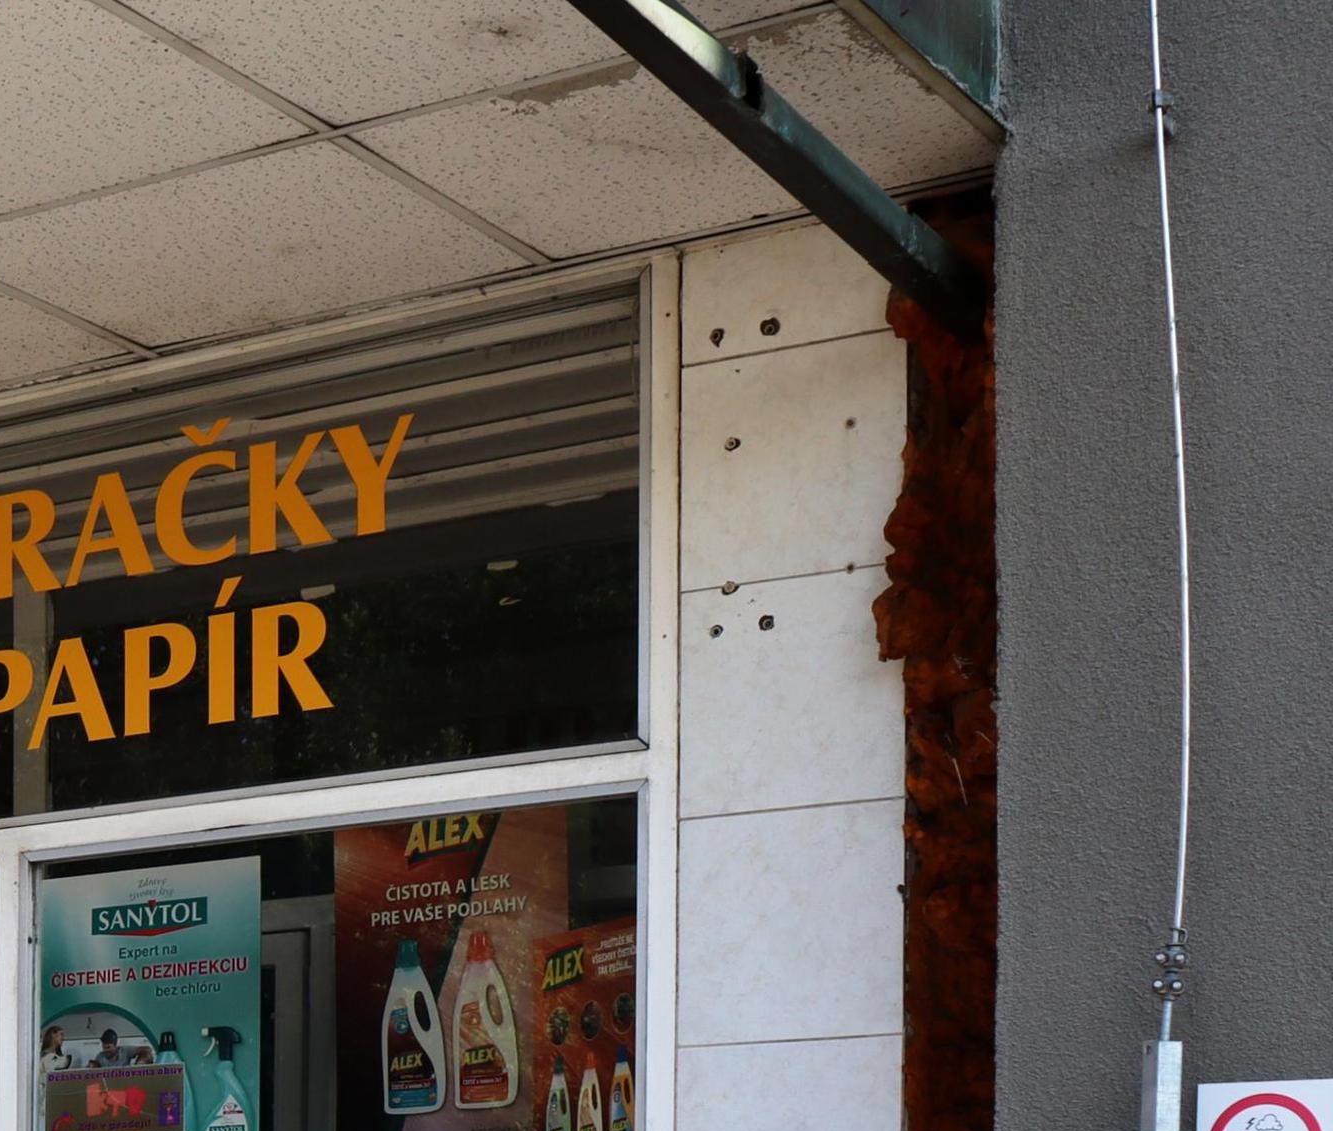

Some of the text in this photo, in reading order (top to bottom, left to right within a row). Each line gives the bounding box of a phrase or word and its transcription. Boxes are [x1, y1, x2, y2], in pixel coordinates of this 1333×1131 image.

[404, 814, 485, 857] ALEX
[386, 874, 510, 901] ČISTOTA A LESK
[98, 902, 202, 931] SANYTOL
[371, 895, 528, 927] PRE VAŠE PODLAHY
[119, 945, 177, 960] Expert na
[51, 957, 248, 989] ČISTENIE A DEZINFEKCIU
[541, 949, 583, 991] ALEX
[156, 981, 221, 998] bez chlóru
[390, 1055, 423, 1071] ALEX
[462, 1049, 493, 1065] ALEX
